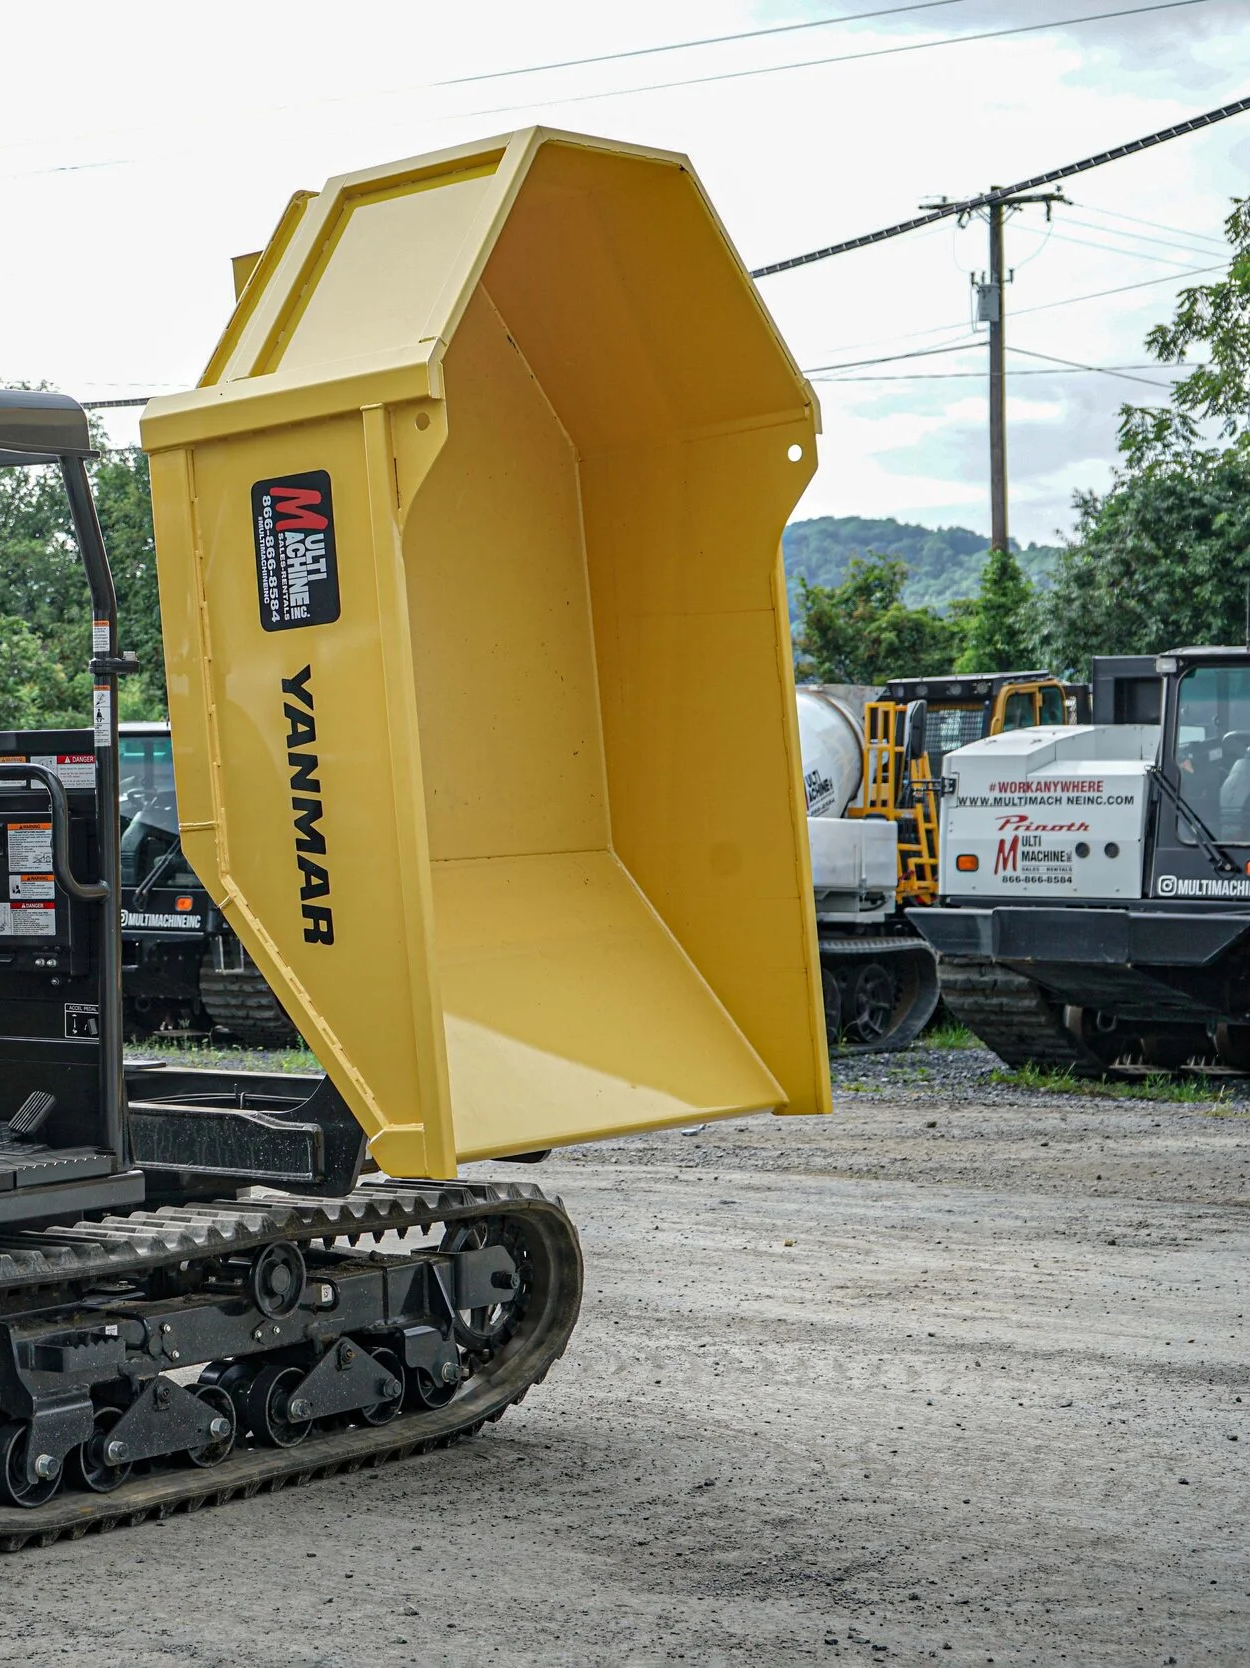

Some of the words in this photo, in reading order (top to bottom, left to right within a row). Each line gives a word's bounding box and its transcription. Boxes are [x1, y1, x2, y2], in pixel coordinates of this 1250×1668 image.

[262, 495, 281, 622] 866-866-8584
[278, 533, 290, 621] SALES-RENTALS
[291, 605, 310, 620] INC.
[989, 780, 1104, 793] #WORKANYWHERE
[282, 664, 334, 945] YANMAR
[995, 814, 1090, 832] Prinoth
[1021, 850, 1066, 862] MACHINE
[1002, 876, 1073, 884] 866-866-8584
[1177, 879, 1250, 896] MULTIMACHI
[128, 913, 202, 928] MULTIMACHINEINC
